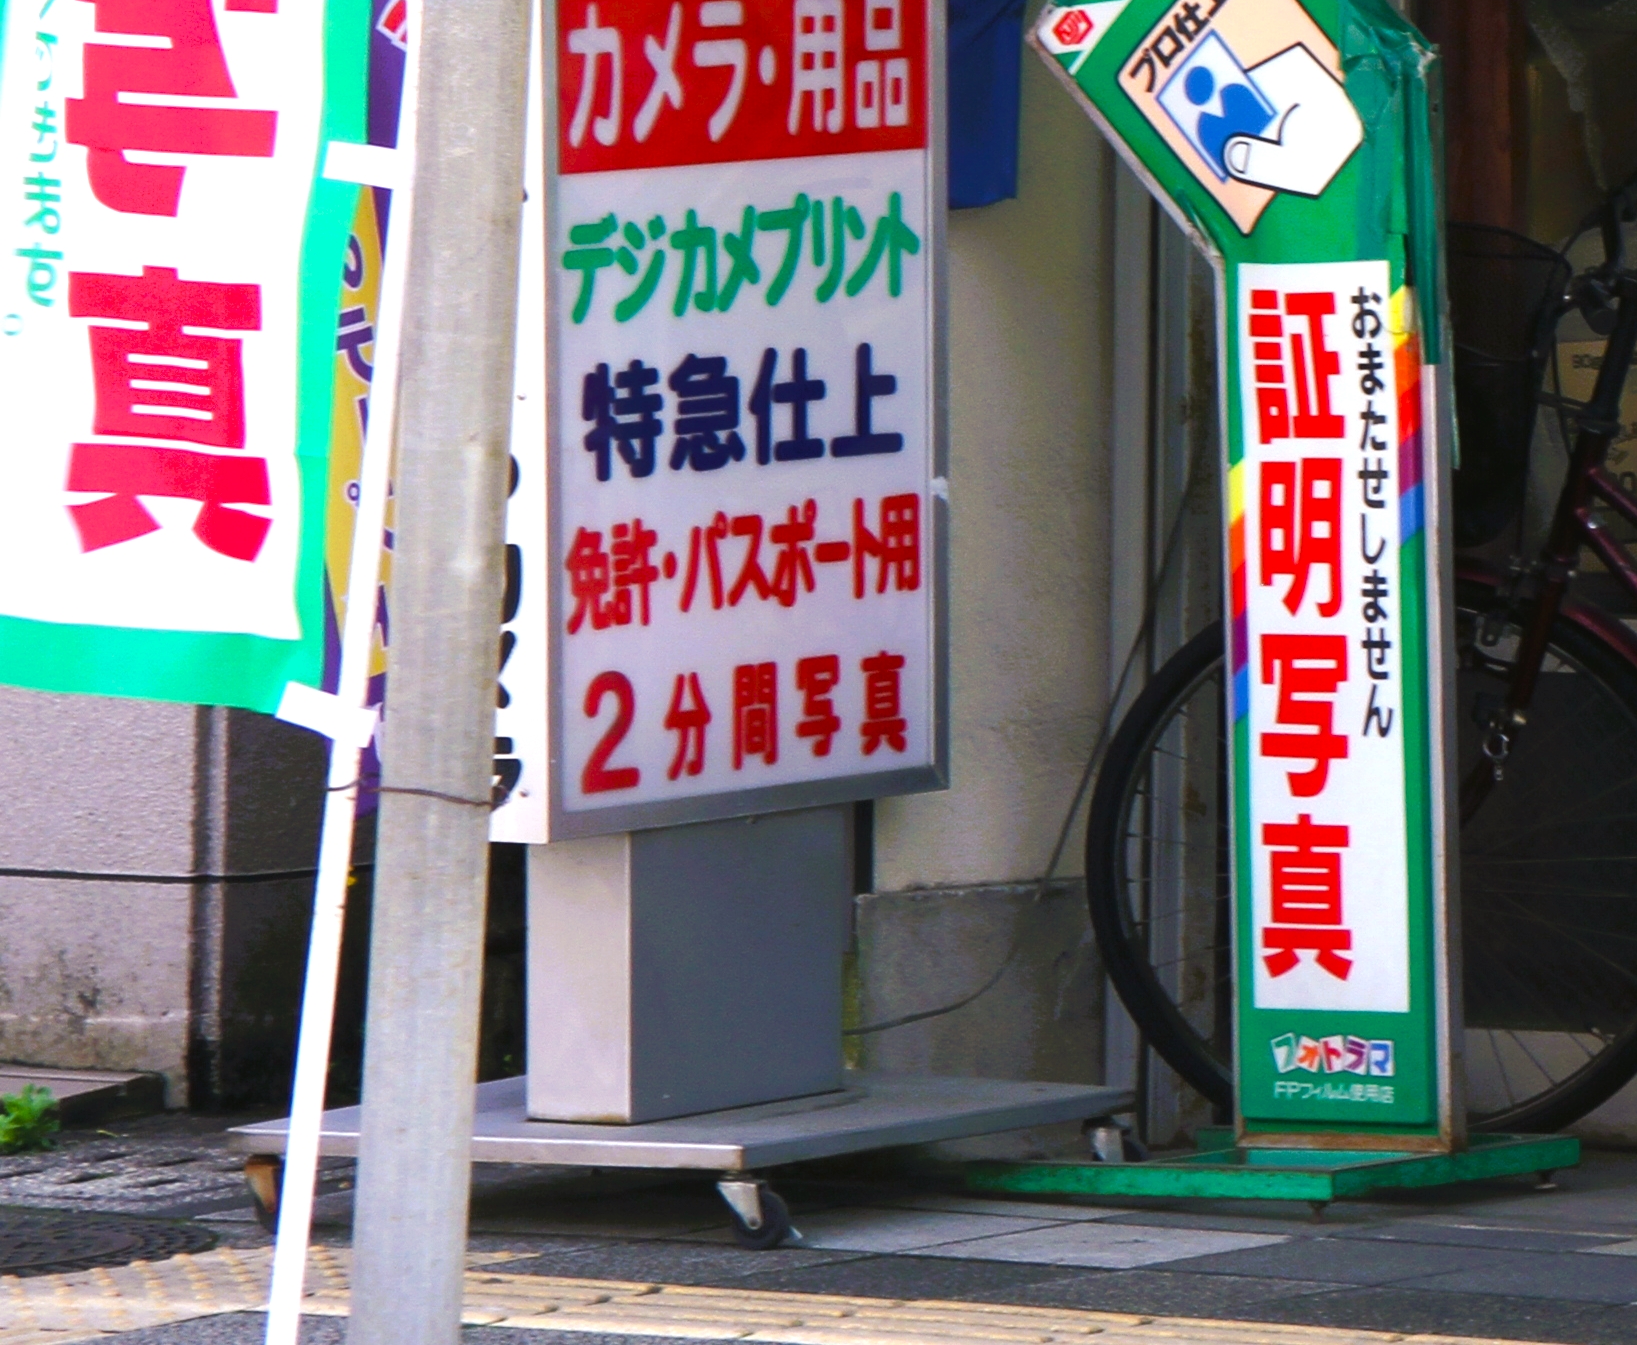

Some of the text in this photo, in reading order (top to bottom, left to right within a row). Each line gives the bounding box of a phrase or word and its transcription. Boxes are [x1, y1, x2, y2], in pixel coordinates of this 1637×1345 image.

[561, 191, 921, 325] デジカメプリント
[581, 342, 905, 483] 特急仕上
[564, 493, 922, 636] 免許・パスポート用
[1350, 284, 1394, 739] おまたせしません
[1248, 288, 1355, 984] 証明写真
[580, 652, 910, 795] 2分間写真
[1271, 1036, 1394, 1077] フォトラマ
